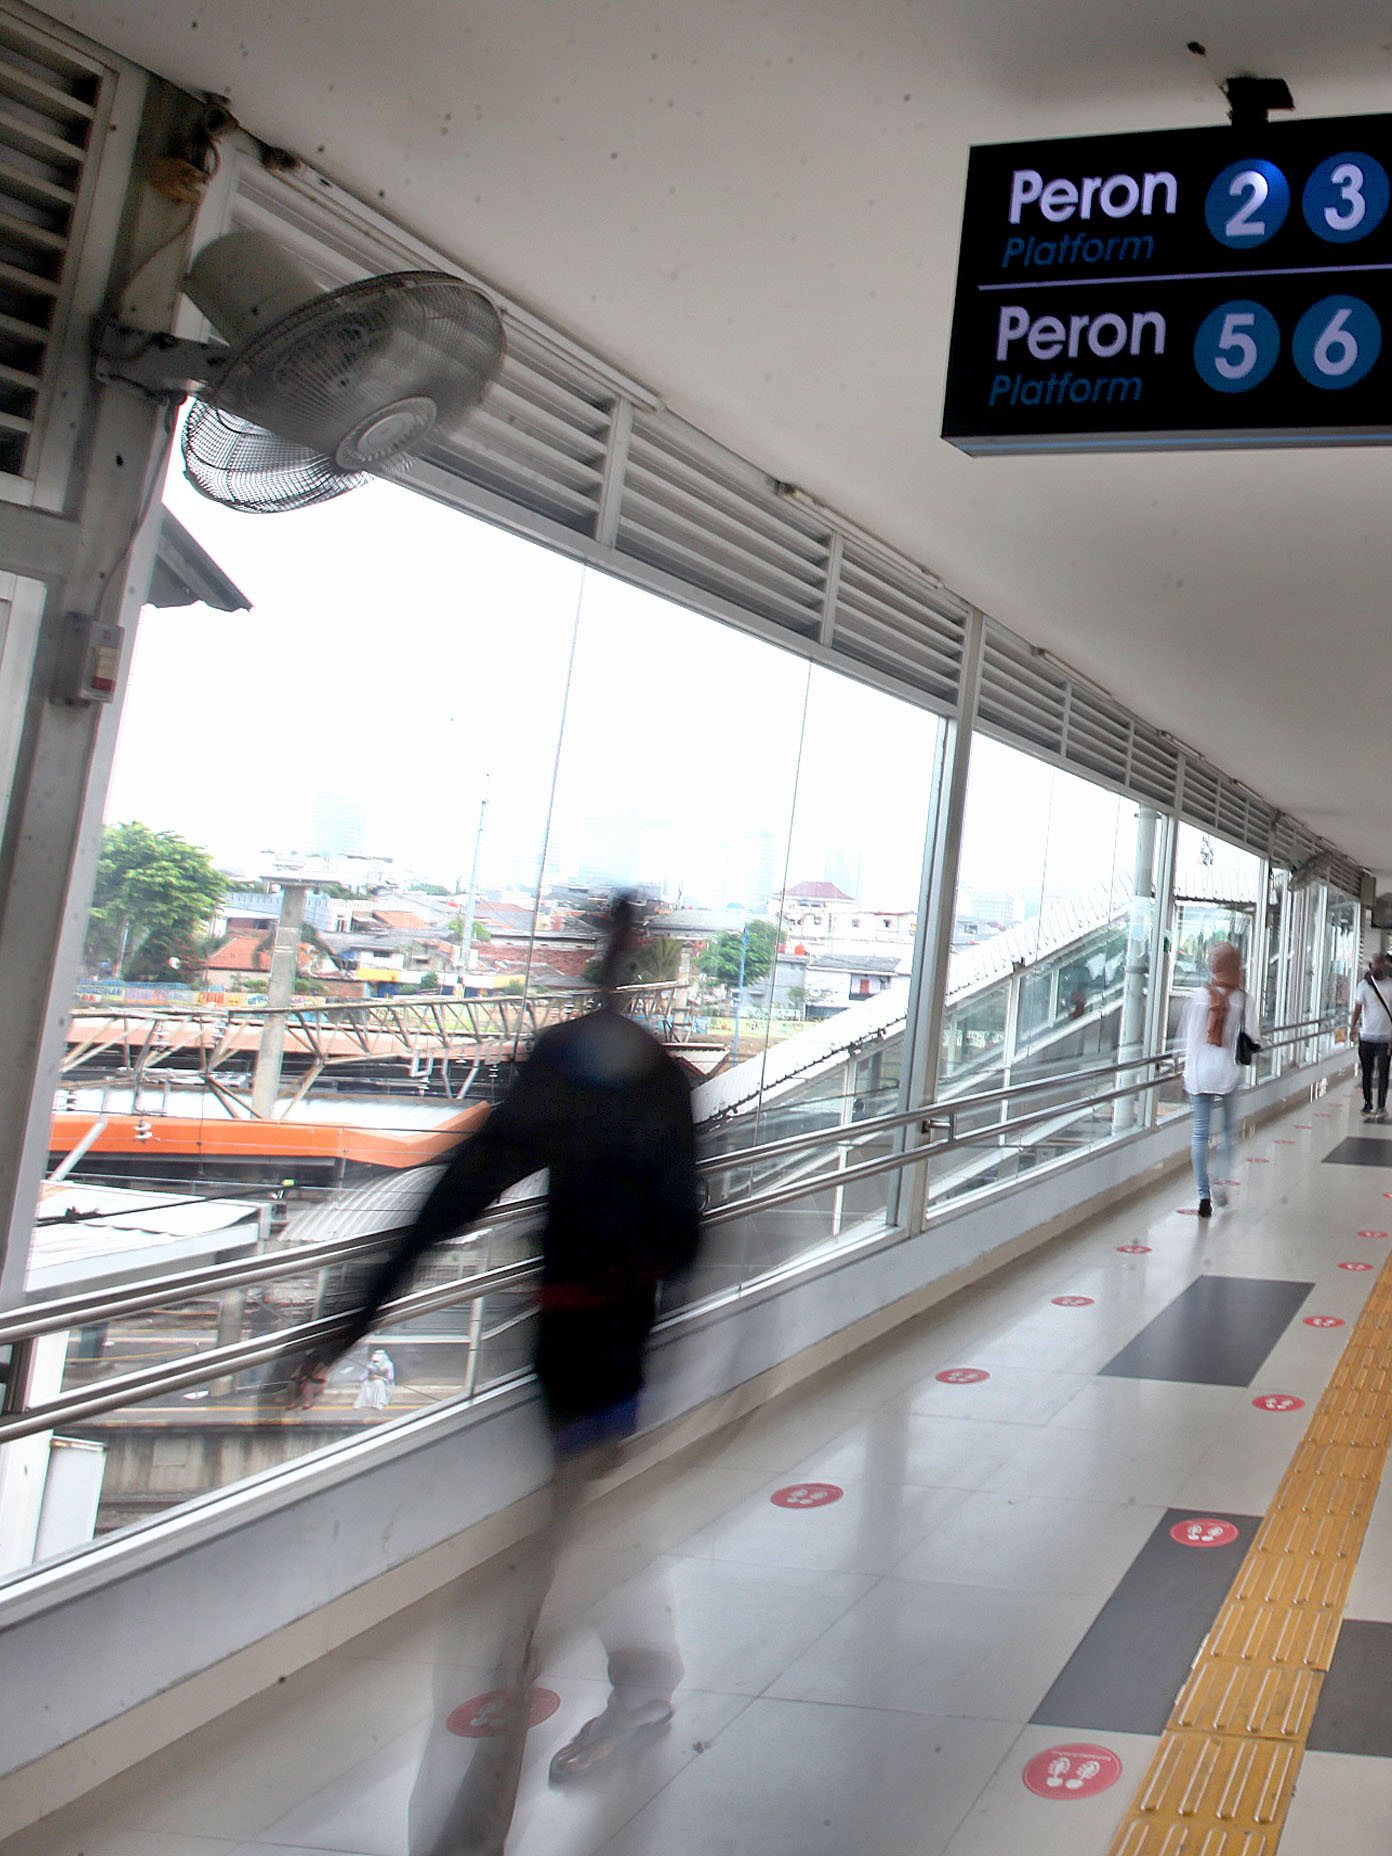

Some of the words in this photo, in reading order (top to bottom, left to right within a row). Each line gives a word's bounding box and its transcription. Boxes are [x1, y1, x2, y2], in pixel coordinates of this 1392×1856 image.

[1009, 169, 1178, 224] Peron
[1226, 171, 1269, 236] 2
[1325, 164, 1366, 230] 3
[1002, 232, 1154, 268] Platform
[996, 306, 1166, 361] Peron
[1215, 313, 1258, 380] 5
[1313, 309, 1358, 375] 6
[988, 372, 1142, 406] Platform
